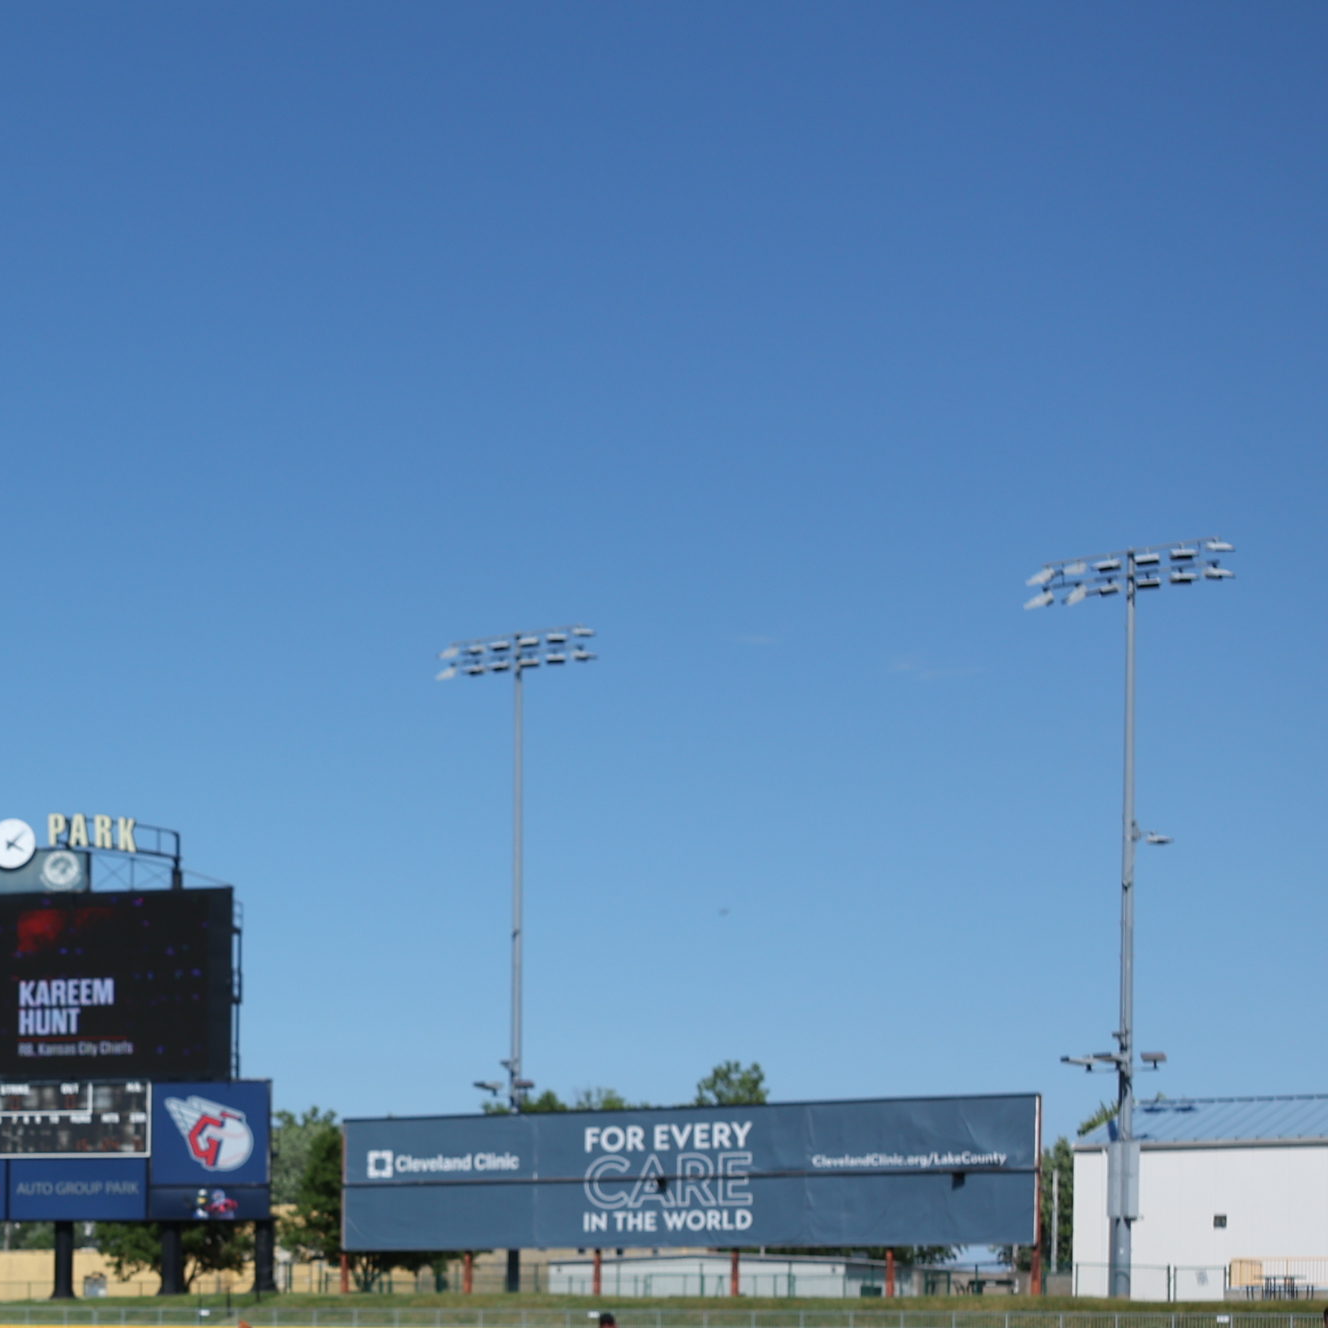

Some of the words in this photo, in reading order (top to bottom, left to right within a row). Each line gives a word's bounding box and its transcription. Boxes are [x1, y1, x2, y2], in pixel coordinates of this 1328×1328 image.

[48, 813, 137, 852] PARK
[19, 978, 114, 1007] KAREEM
[19, 1007, 80, 1036] HUNT
[585, 1125, 644, 1152] FOR
[653, 1122, 752, 1151] EVERY
[395, 1154, 472, 1172] Cleveland
[475, 1152, 520, 1170] Clinic
[812, 1151, 1007, 1168] ClevelandClinic.org/LakeCounty
[16, 1182, 53, 1195] AUTO
[55, 1181, 103, 1195] GROUP
[105, 1181, 139, 1195] PARK
[584, 1152, 753, 1209] CARE
[583, 1211, 607, 1232] IN
[612, 1210, 657, 1232] THE
[663, 1209, 752, 1231] WORLD
